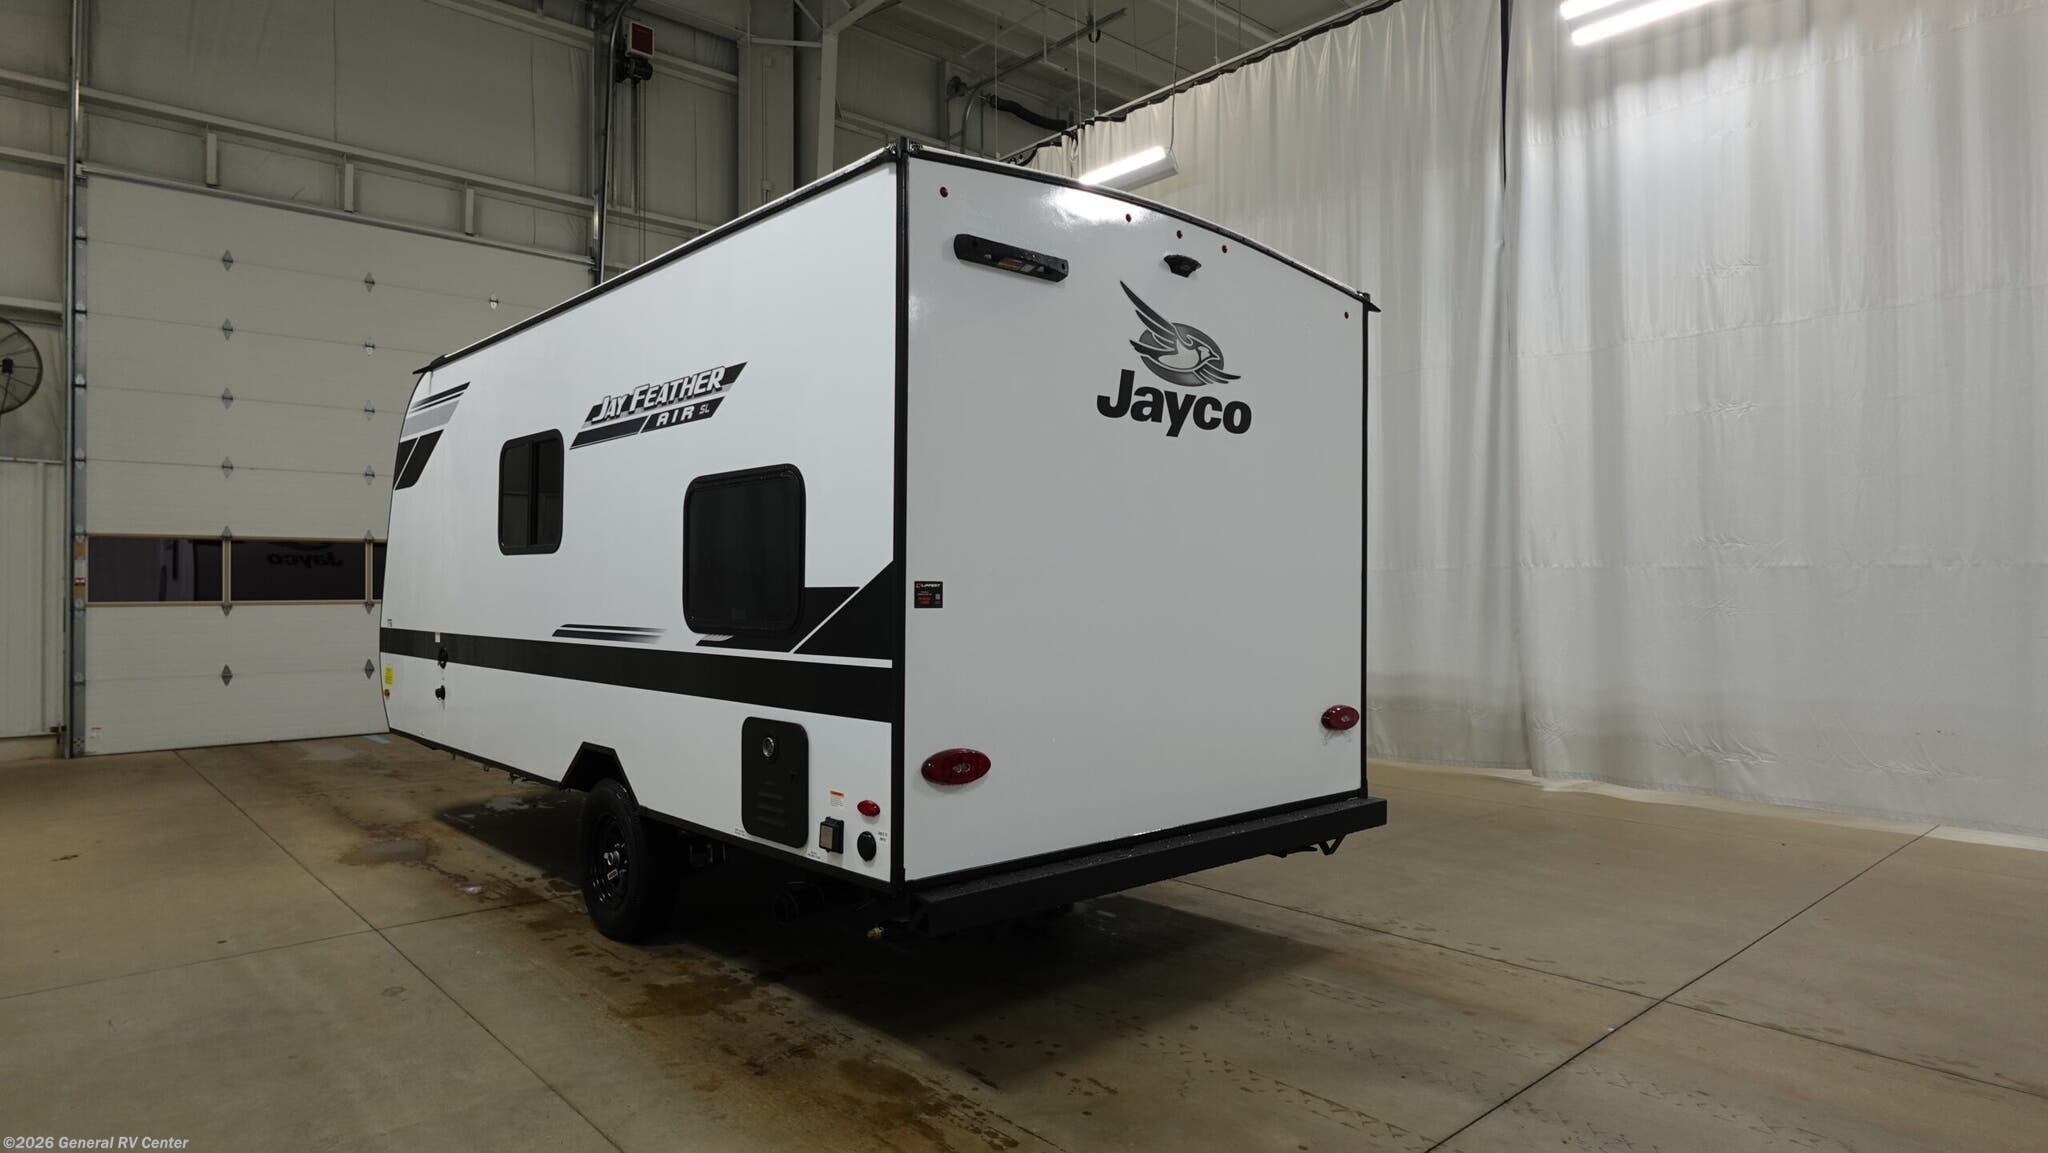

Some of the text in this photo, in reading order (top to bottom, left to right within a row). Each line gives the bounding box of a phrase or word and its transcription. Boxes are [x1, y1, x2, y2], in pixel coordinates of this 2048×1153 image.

[592, 366, 726, 423] JAY FEATHER
[656, 404, 710, 427] AIR SL
[1096, 368, 1252, 438] Jayco
